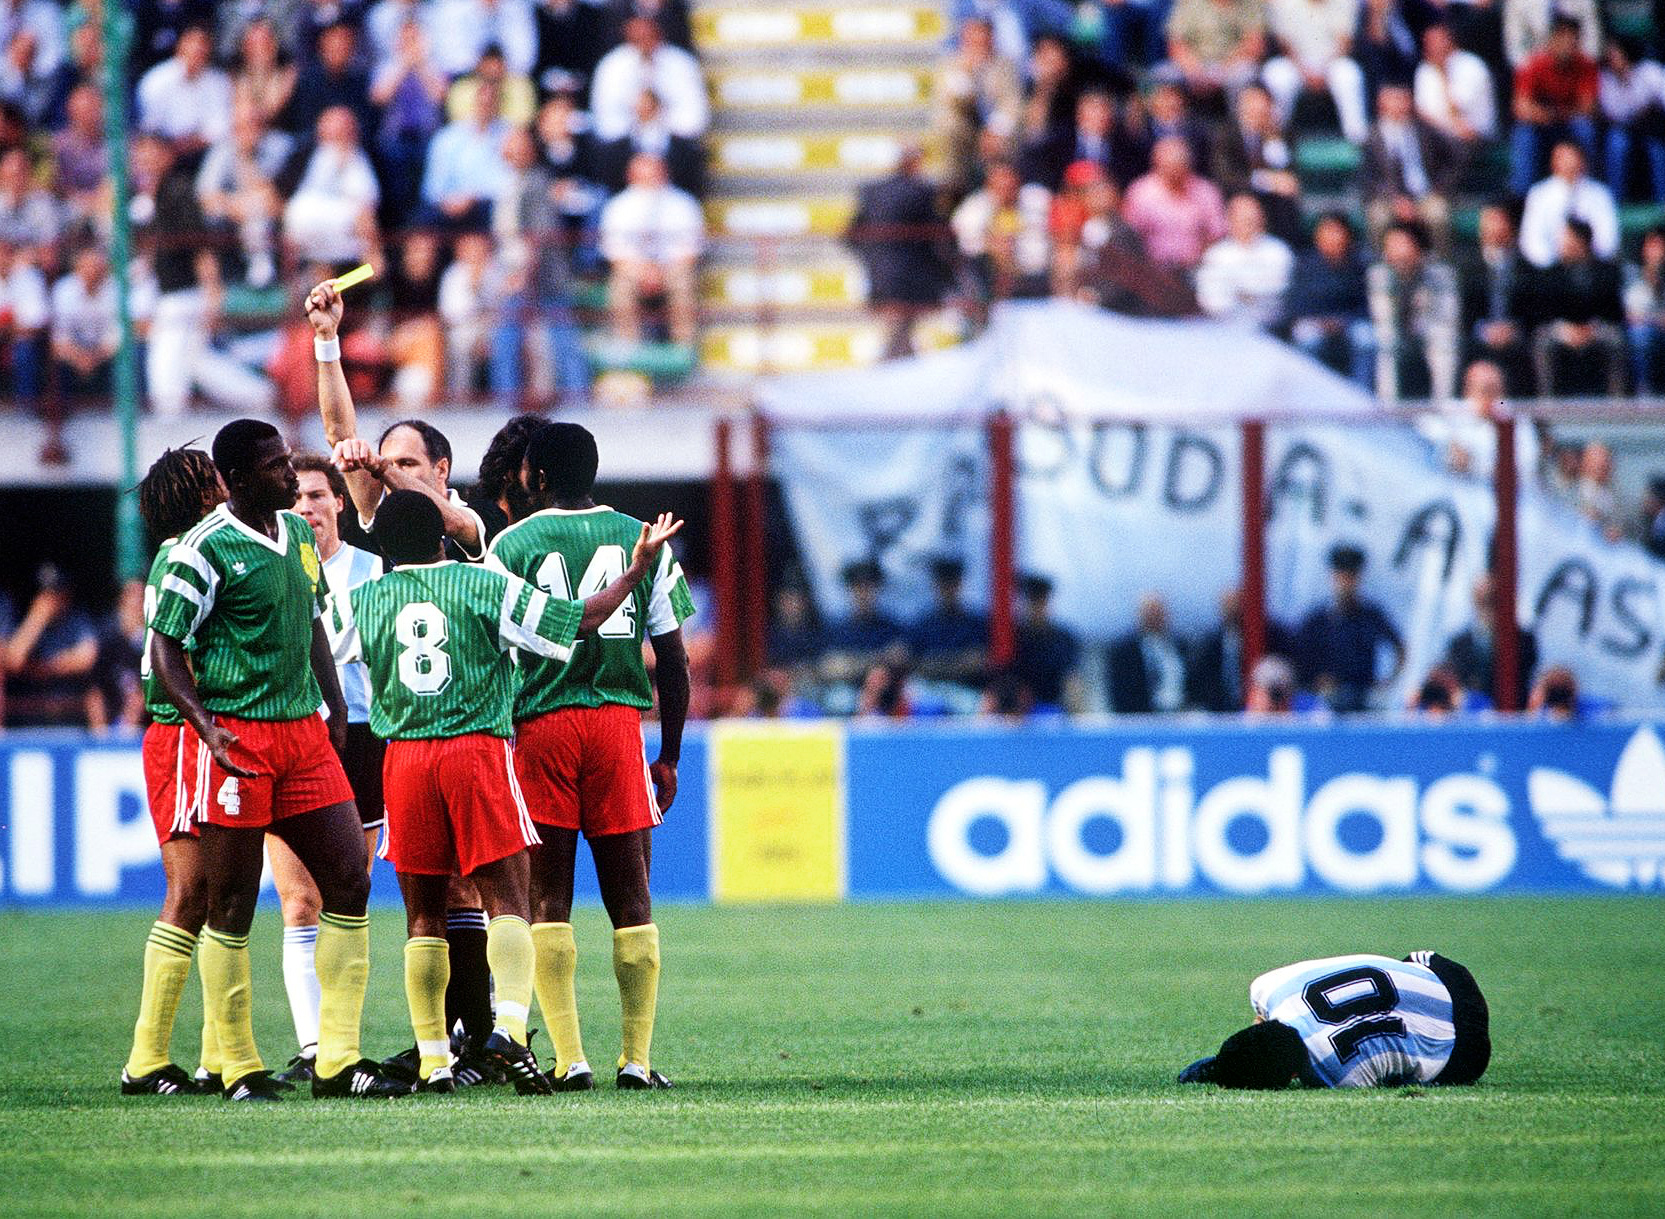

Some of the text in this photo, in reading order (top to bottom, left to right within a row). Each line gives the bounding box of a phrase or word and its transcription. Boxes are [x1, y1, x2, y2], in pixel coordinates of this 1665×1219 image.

[536, 544, 636, 638] 14
[396, 601, 452, 696] 8
[217, 775, 241, 816] 4
[926, 745, 1518, 896] adidas
[1302, 964, 1407, 1064] 10
